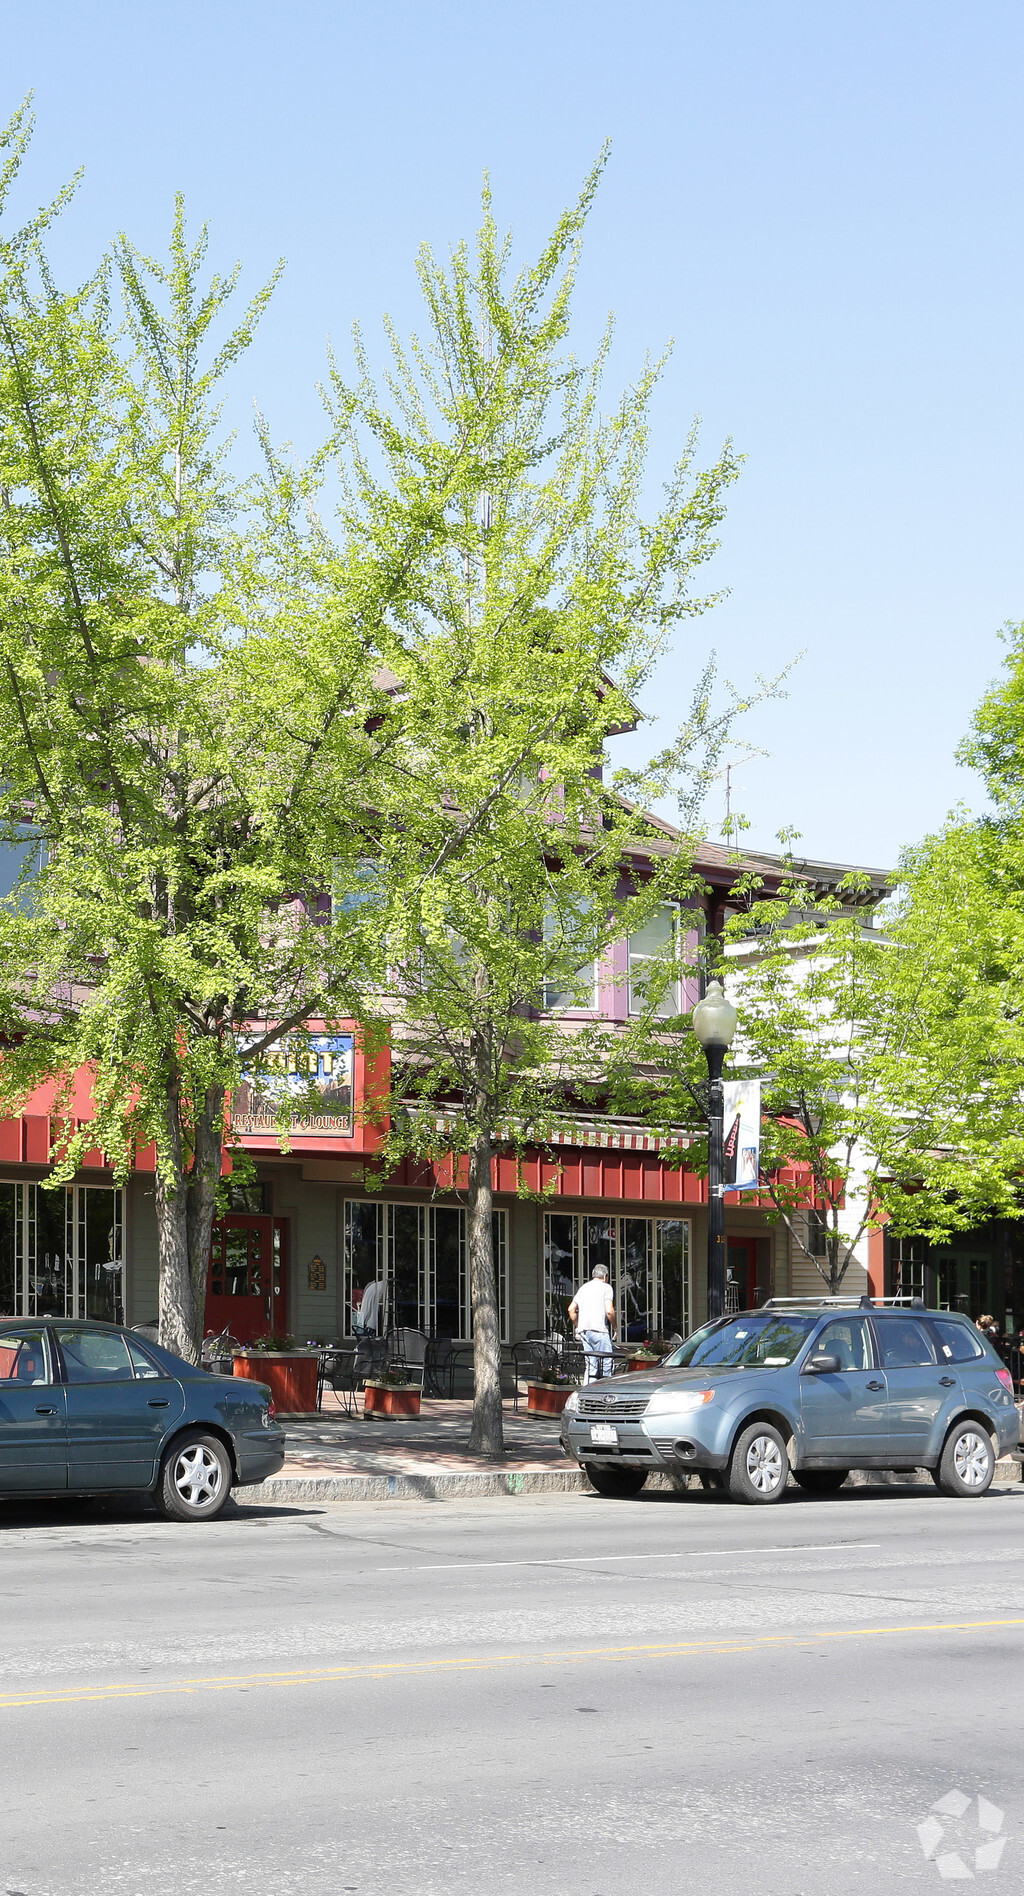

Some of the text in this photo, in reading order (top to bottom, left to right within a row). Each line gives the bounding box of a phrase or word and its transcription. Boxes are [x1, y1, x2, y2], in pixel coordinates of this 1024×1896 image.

[235, 1114, 298, 1129] RESTAURT
[310, 1115, 349, 1130] LOUNGE
[725, 1118, 739, 1159] UPPER
